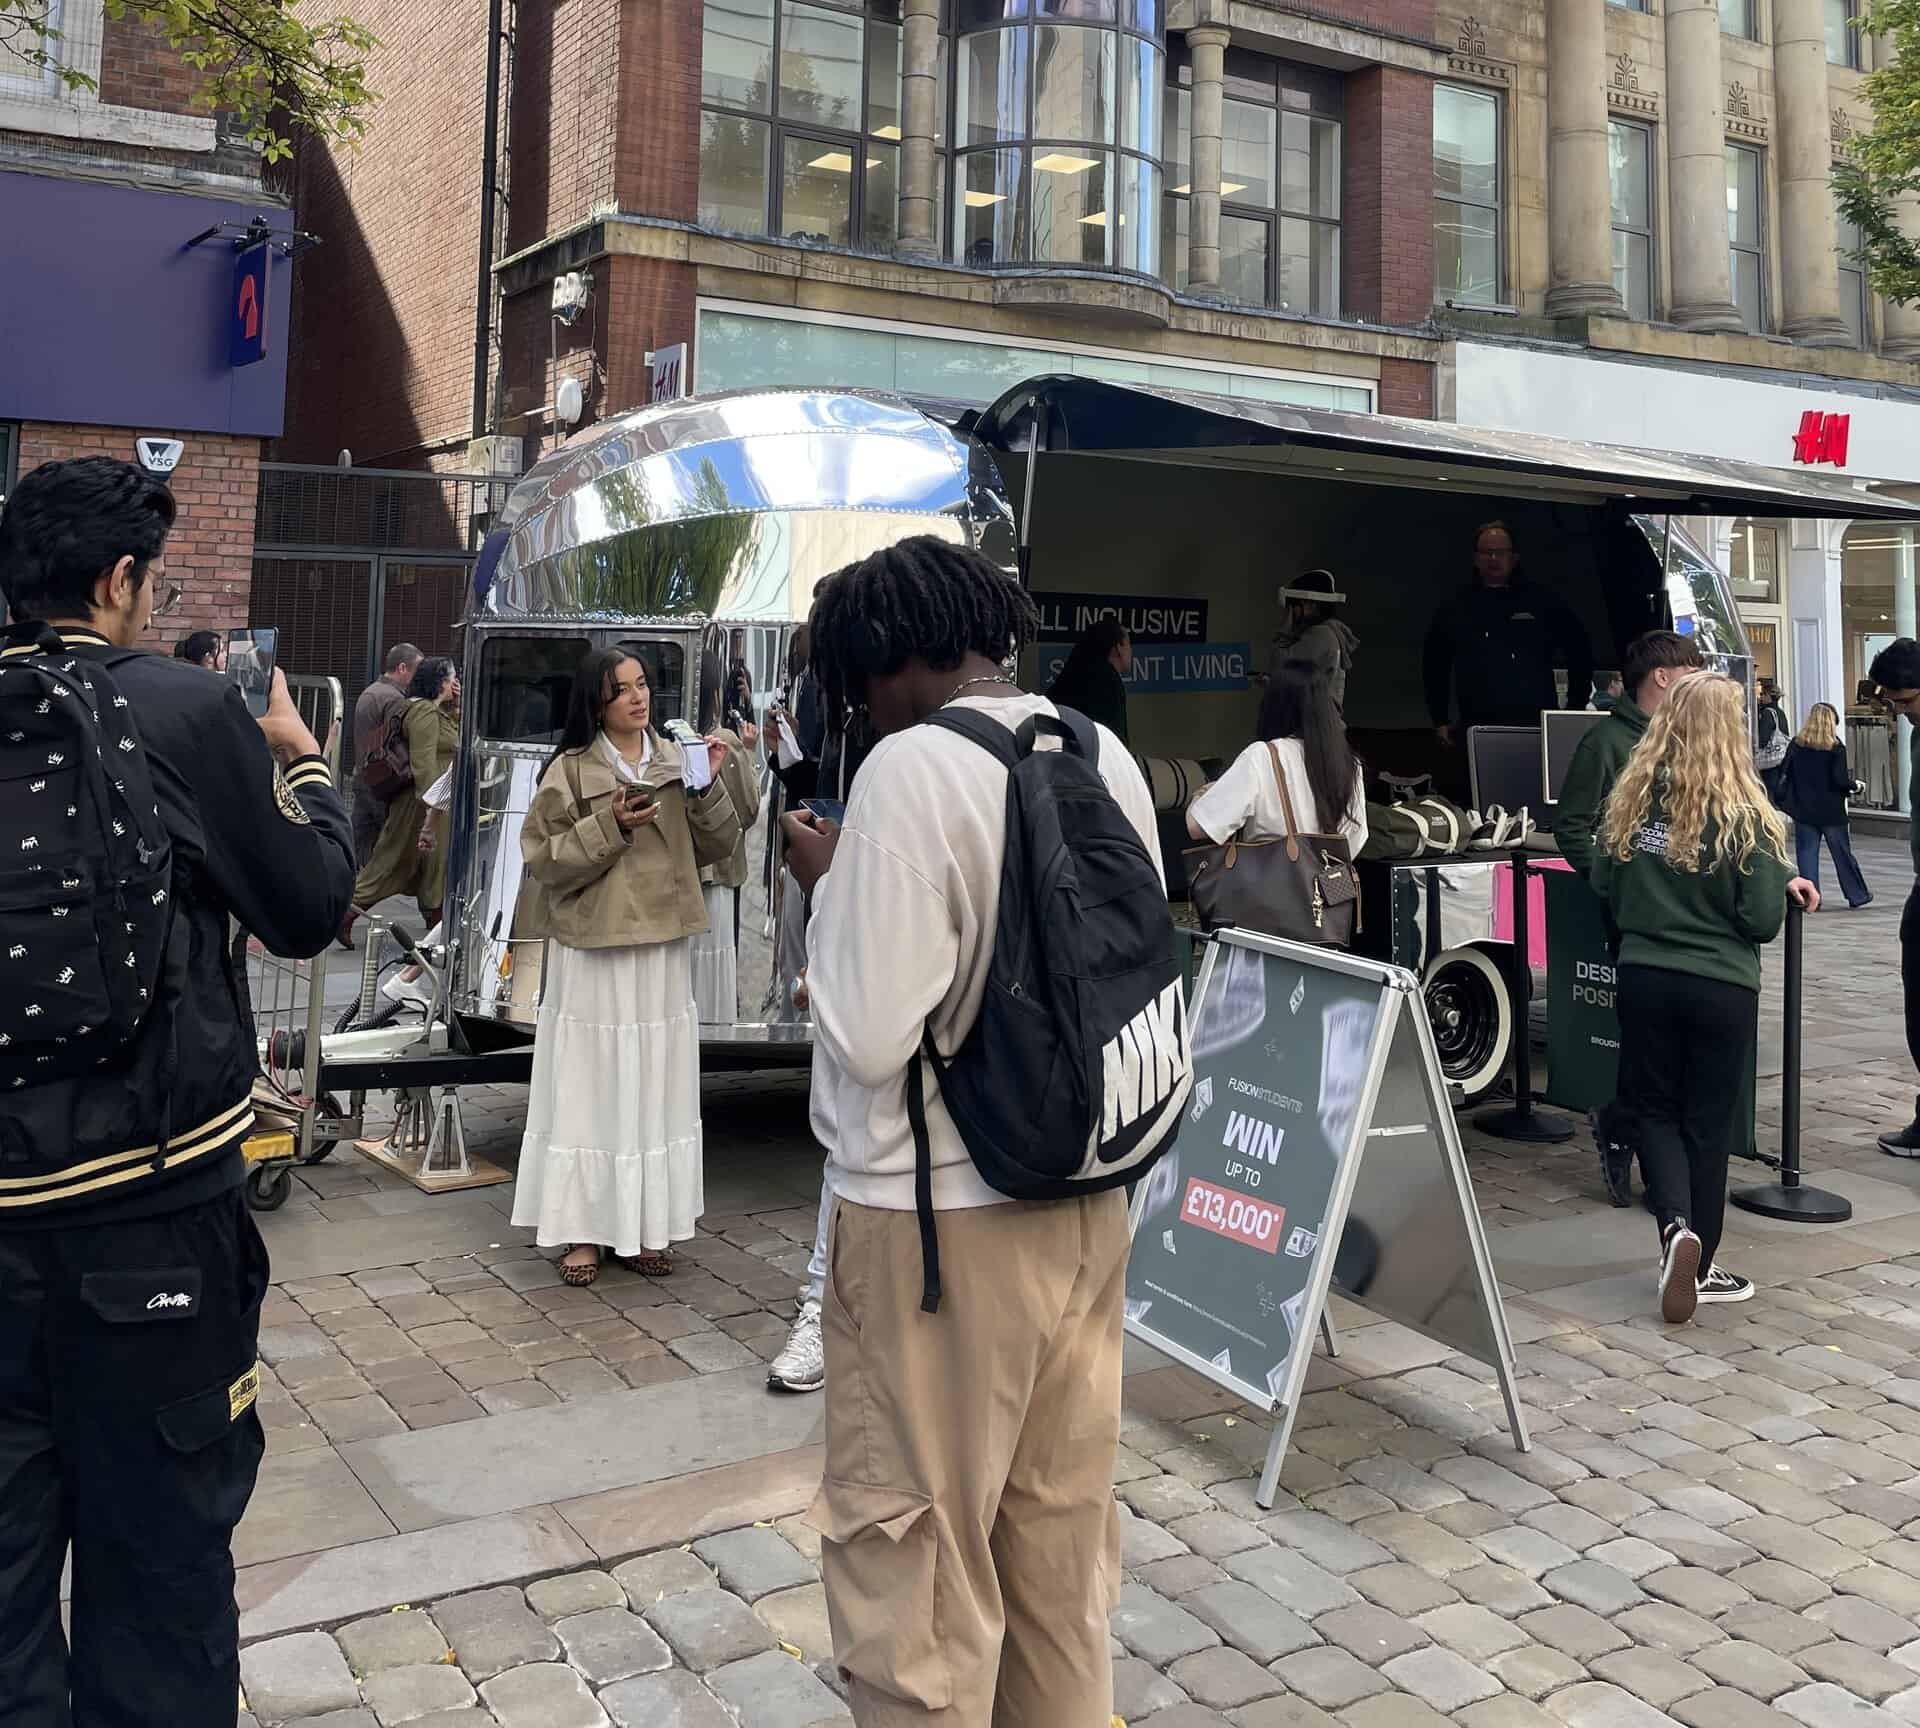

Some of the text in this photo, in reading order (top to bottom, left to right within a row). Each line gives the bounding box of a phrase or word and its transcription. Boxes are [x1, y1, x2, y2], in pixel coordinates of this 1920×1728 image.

[149, 457, 174, 467] VSG
[1039, 604, 1069, 632] LL
[1171, 654, 1245, 681] LIVING
[1576, 960, 1617, 985] DESI
[1222, 1110, 1285, 1166] WIN
[1225, 1159, 1261, 1188] UP TO
